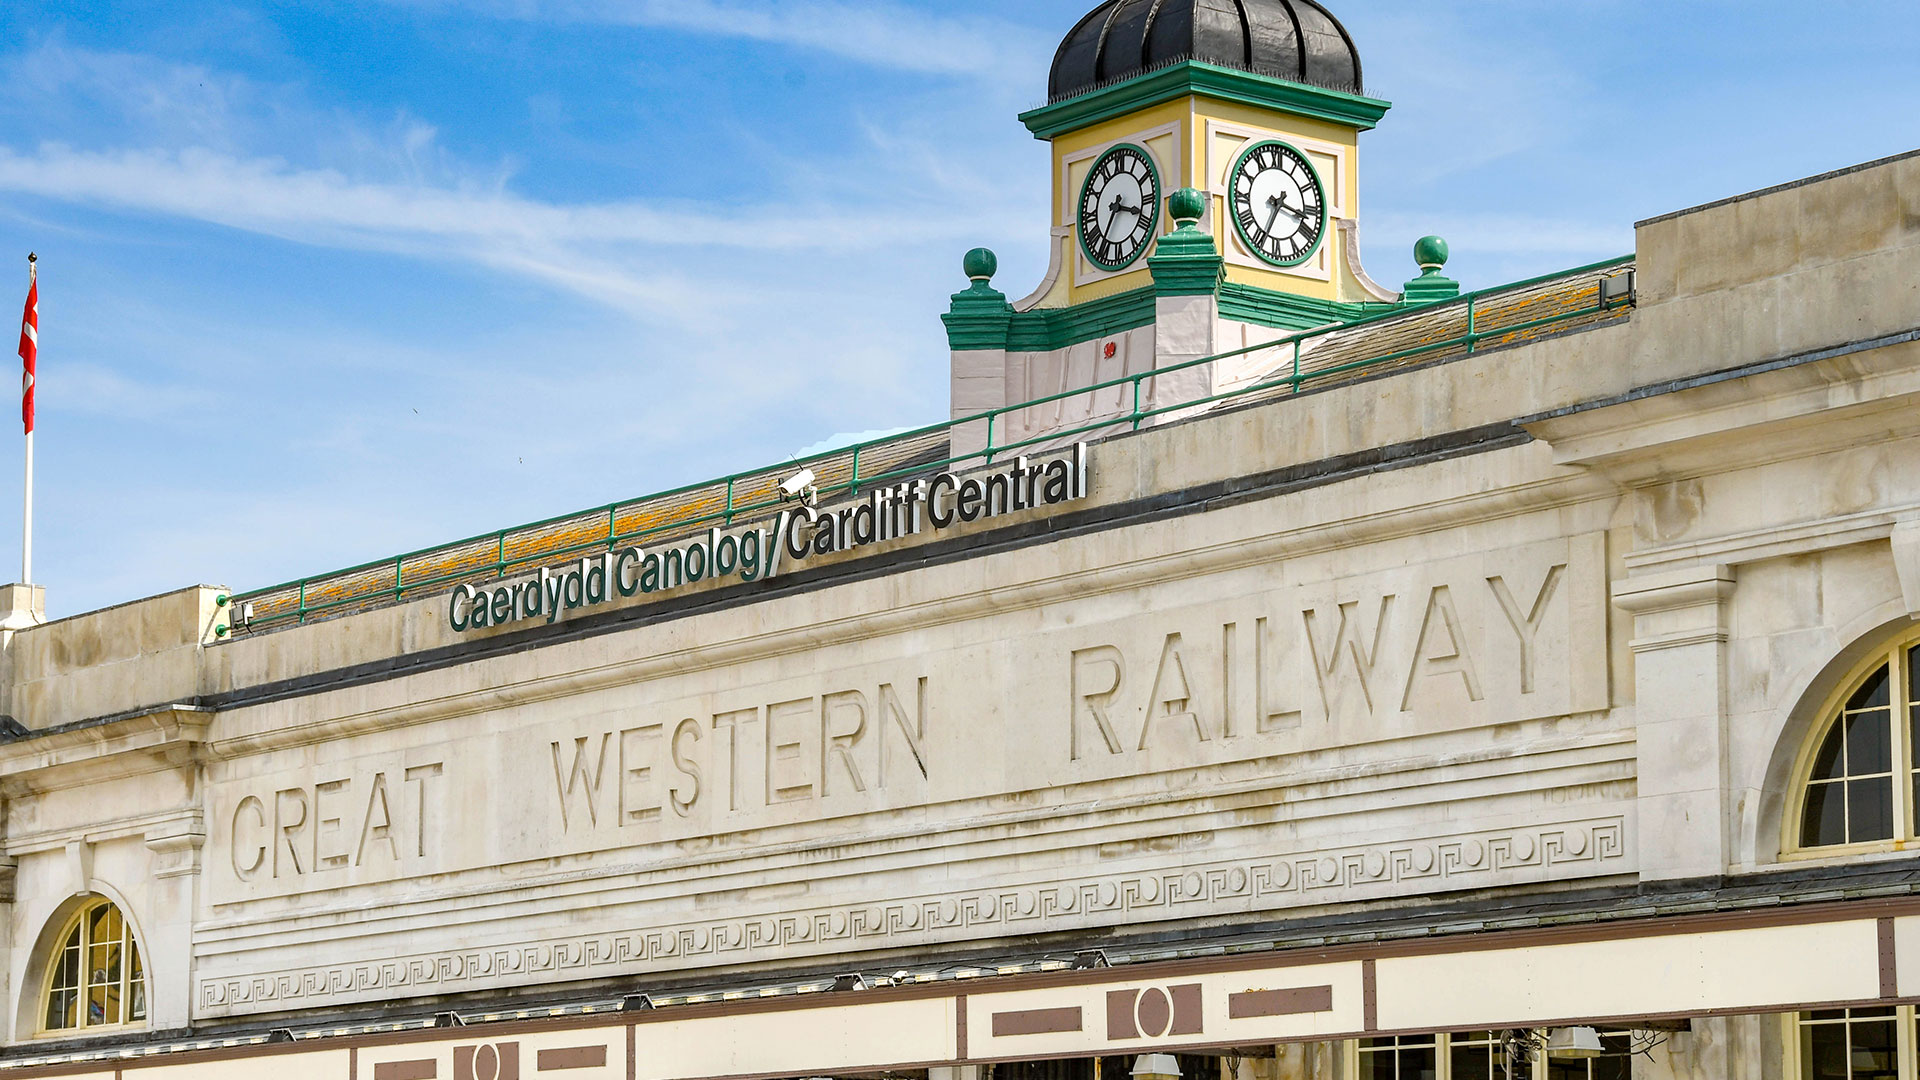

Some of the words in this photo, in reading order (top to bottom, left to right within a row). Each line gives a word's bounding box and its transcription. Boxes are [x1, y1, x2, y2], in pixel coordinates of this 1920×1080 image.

[450, 552, 611, 632] Caerdydd
[927, 442, 1086, 529] Central
[550, 677, 928, 833] WESTERN
[1071, 564, 1567, 760] RAILWAY
